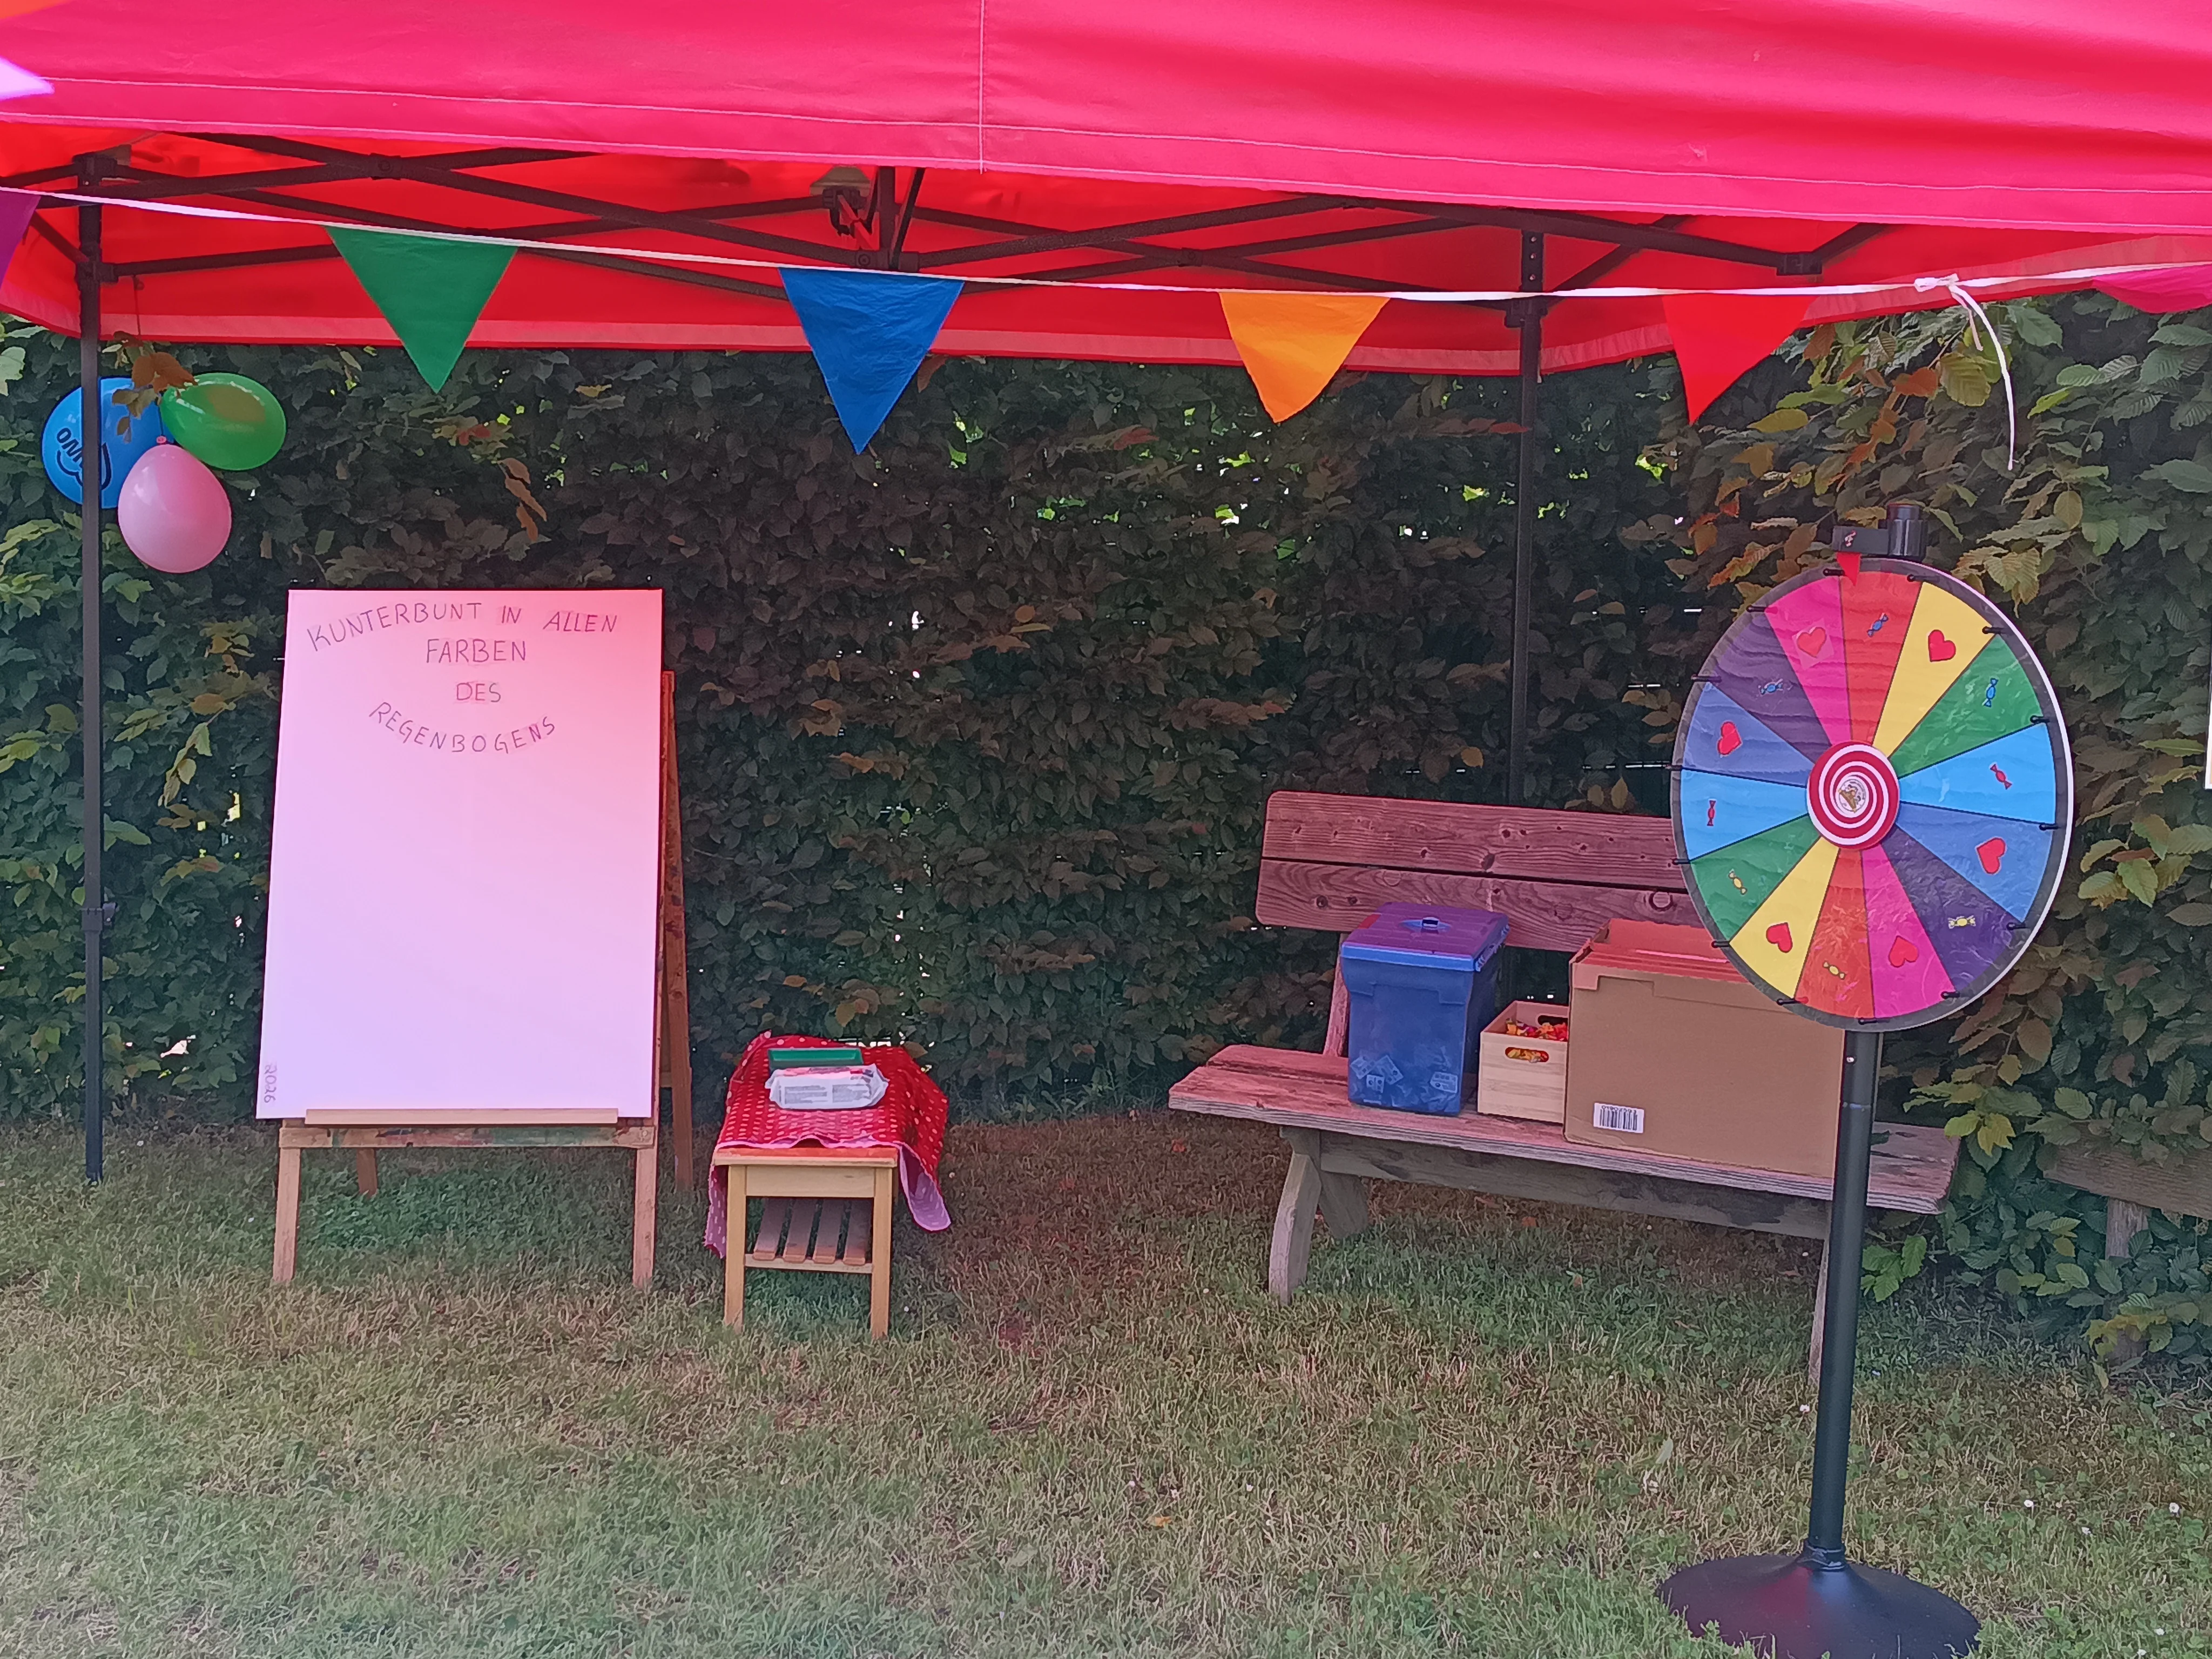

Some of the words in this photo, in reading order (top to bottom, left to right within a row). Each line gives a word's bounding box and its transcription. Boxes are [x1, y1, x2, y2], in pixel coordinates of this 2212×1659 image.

[306, 602, 482, 652] KUNTERBUNT
[501, 605, 522, 624] IN
[542, 610, 618, 633] ALLEN
[426, 638, 526, 664] FARBEN
[456, 681, 501, 703] DES
[368, 702, 556, 754] REGENBOGENS
[264, 1063, 278, 1103] 2026
